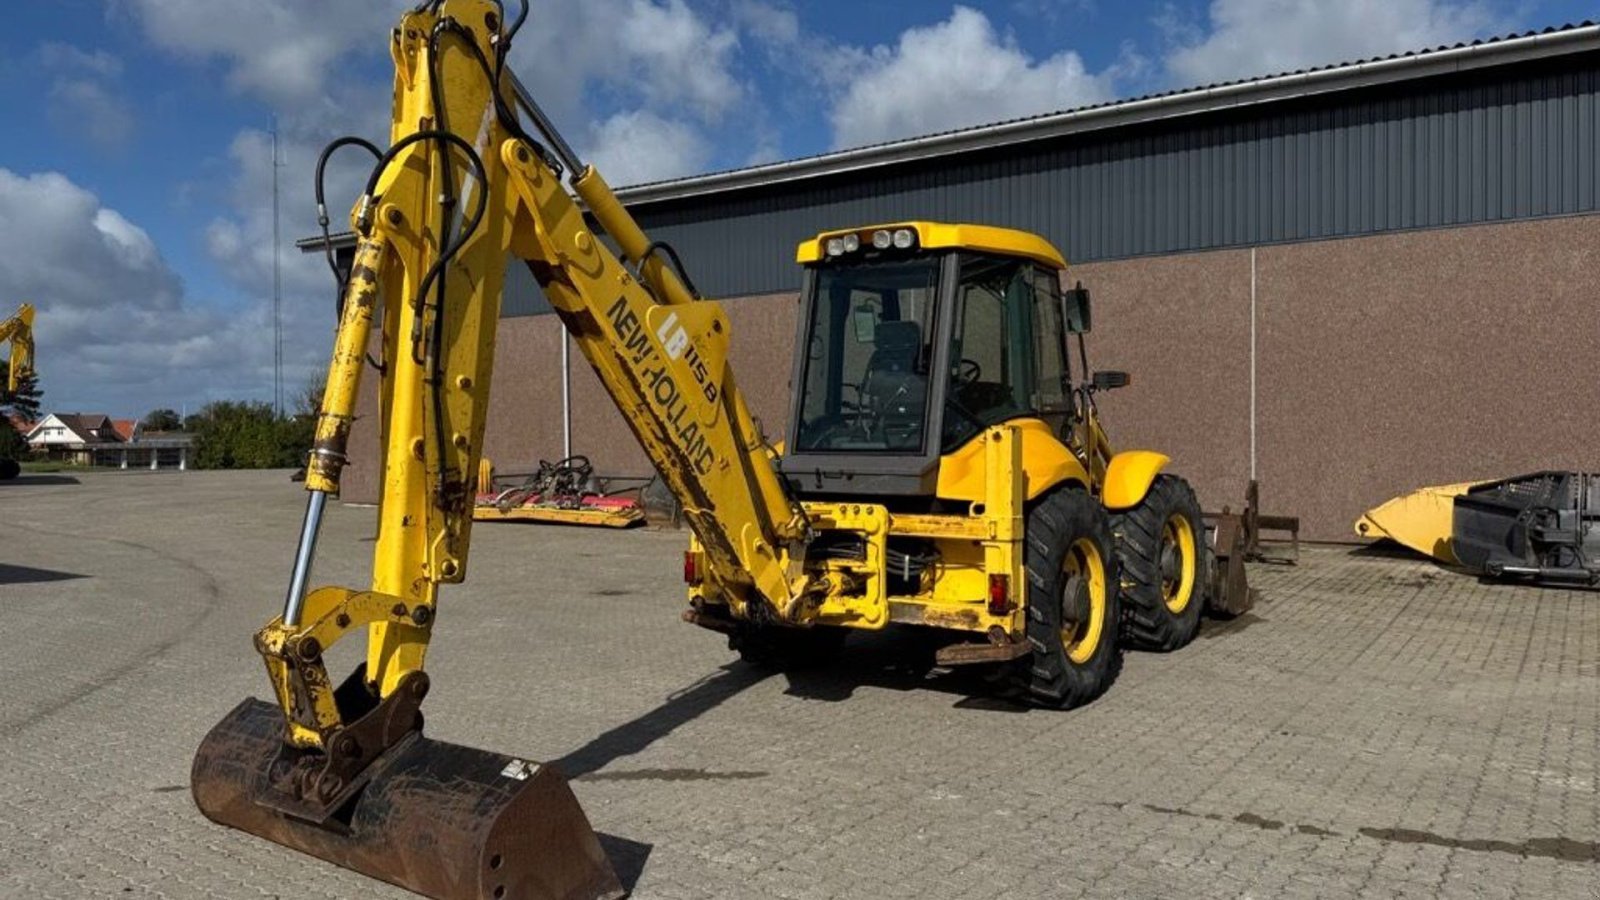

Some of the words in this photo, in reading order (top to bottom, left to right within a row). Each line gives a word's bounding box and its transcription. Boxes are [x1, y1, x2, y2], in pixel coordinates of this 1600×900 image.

[606, 296, 655, 364] NEW
[641, 355, 715, 476] HOLLAND
[656, 312, 689, 361] LB
